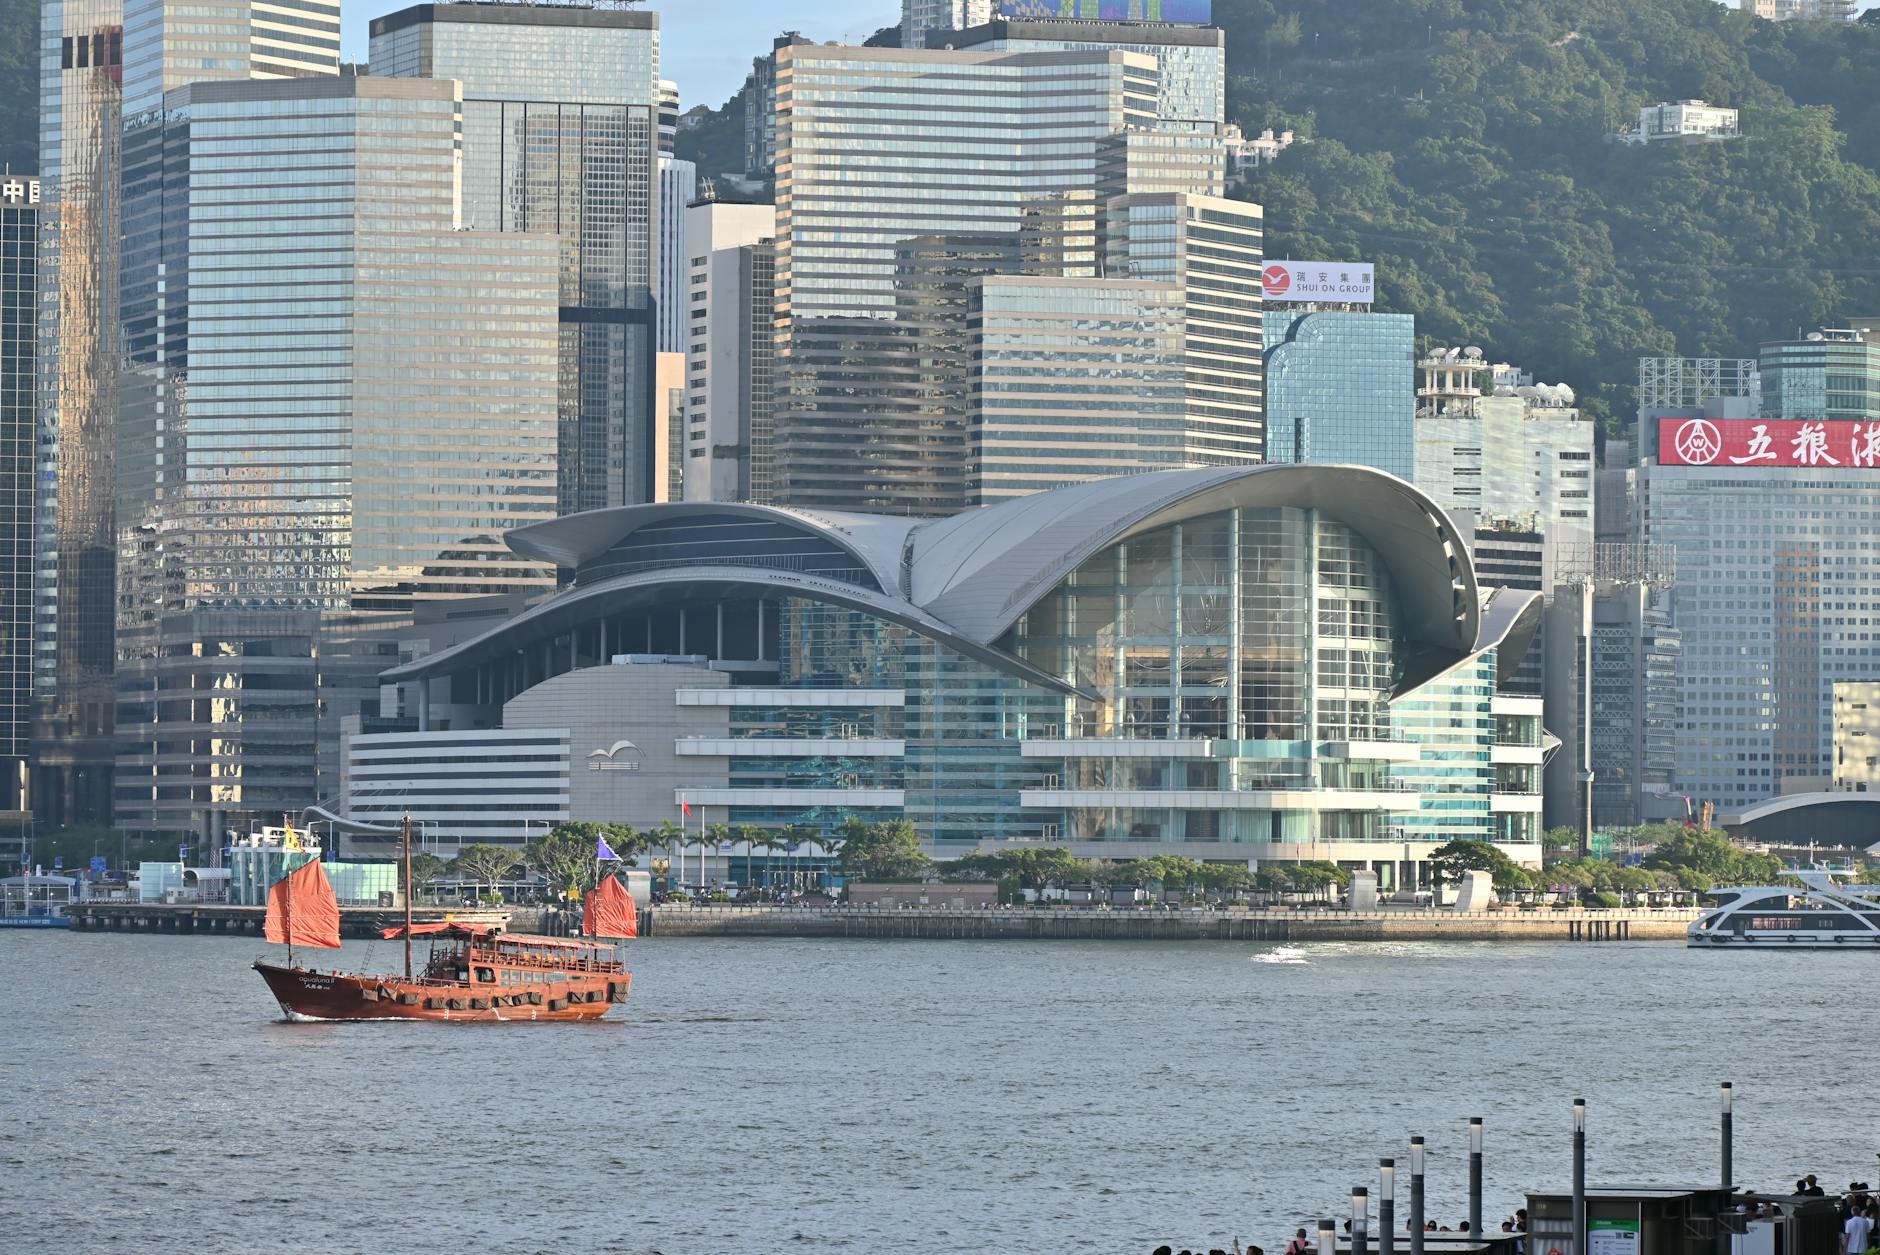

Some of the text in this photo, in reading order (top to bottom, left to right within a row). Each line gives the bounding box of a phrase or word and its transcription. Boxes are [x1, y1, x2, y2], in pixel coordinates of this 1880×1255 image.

[1296, 271, 1371, 284] 瑞安集團
[1296, 284, 1371, 293] SHUI ON GROUP
